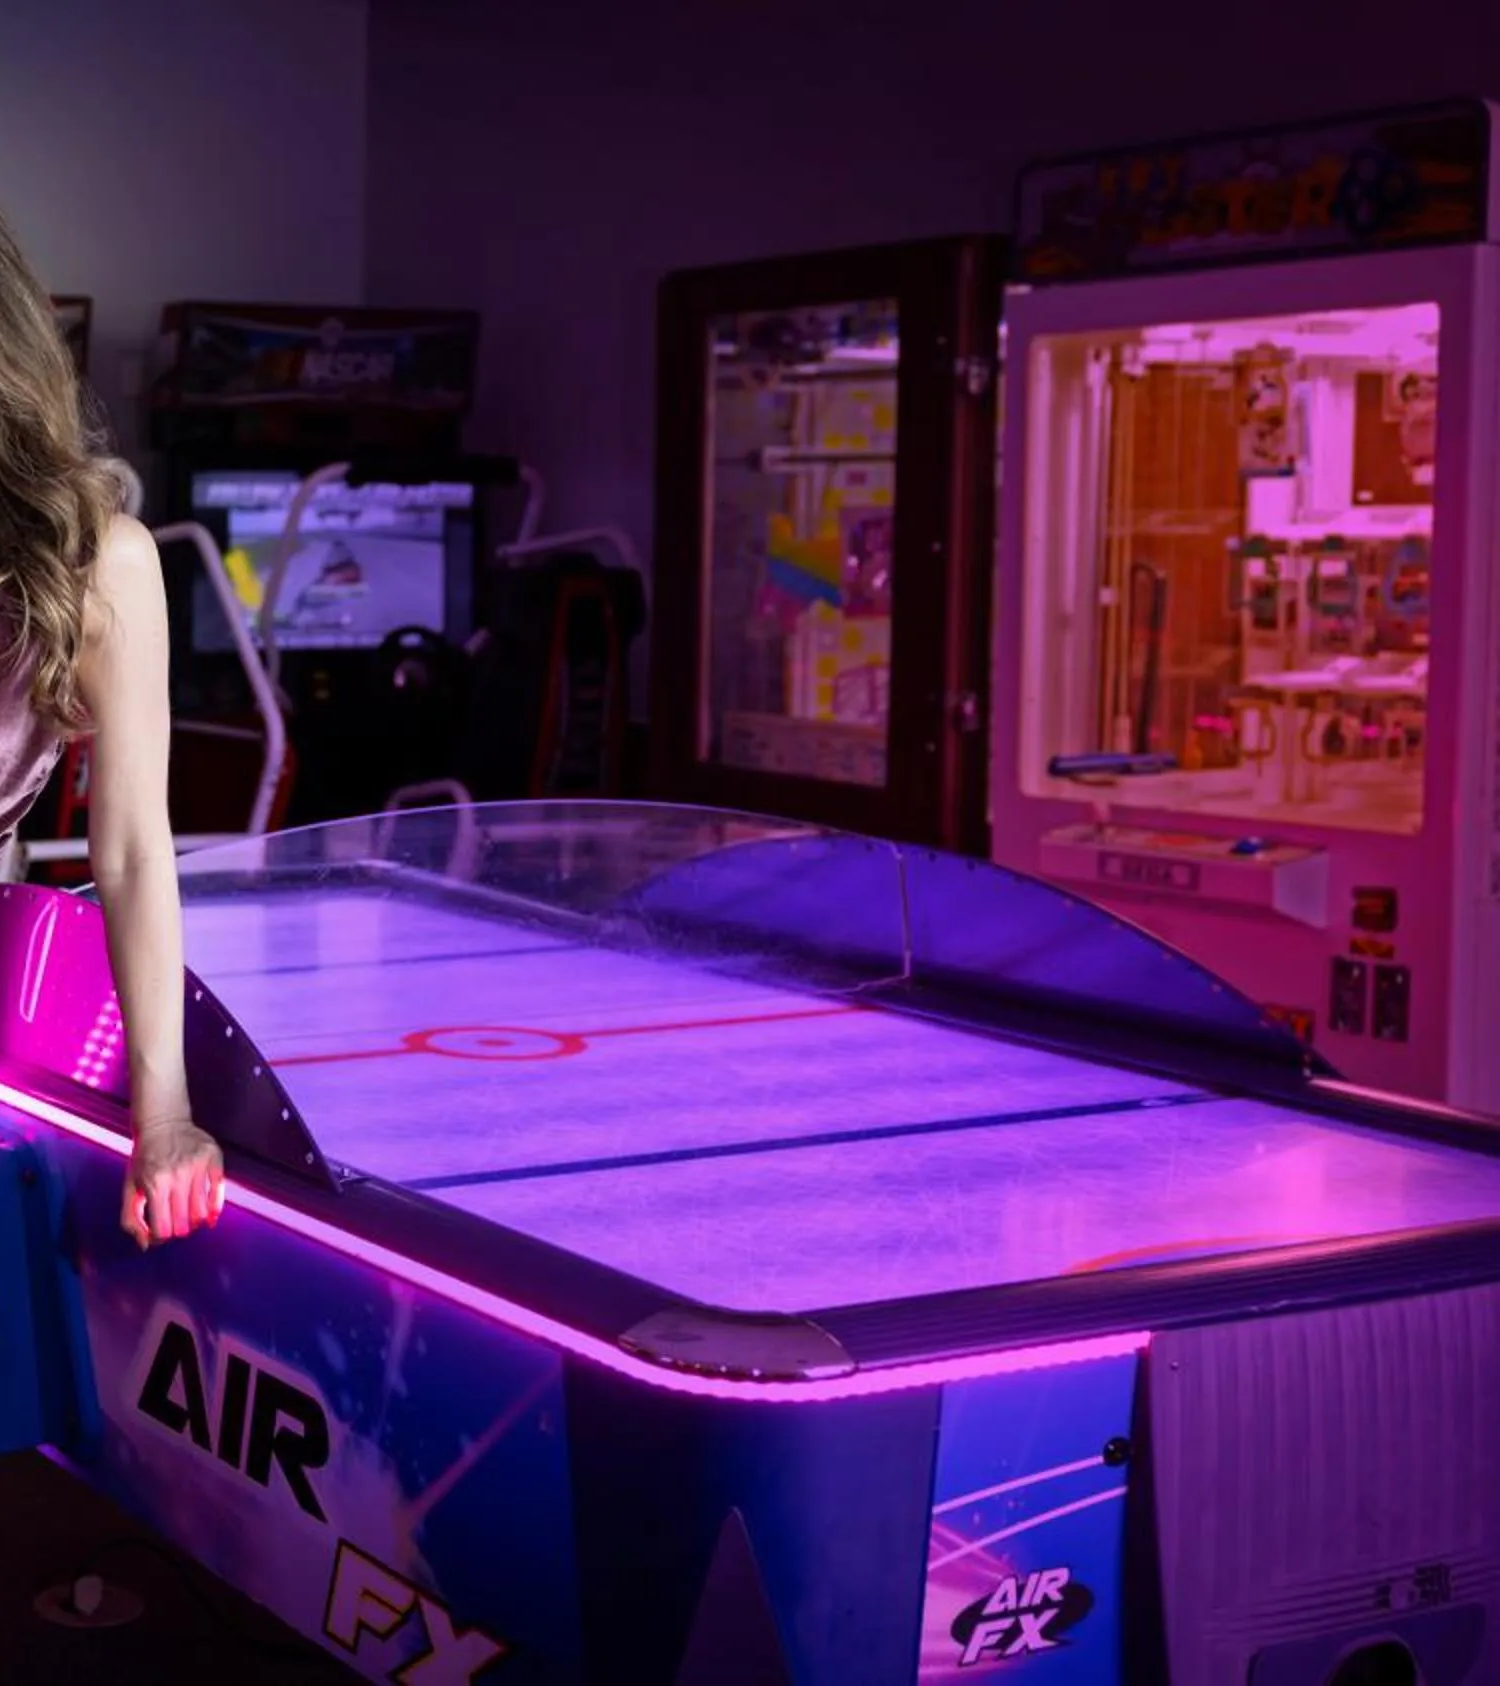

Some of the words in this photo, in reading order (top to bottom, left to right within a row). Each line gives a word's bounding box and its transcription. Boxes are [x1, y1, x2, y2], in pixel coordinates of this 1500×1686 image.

[137, 1321, 330, 1524] AIR
[323, 1537, 508, 1686] FX
[959, 1608, 1062, 1665] FX
[981, 1567, 1070, 1614] AIR
